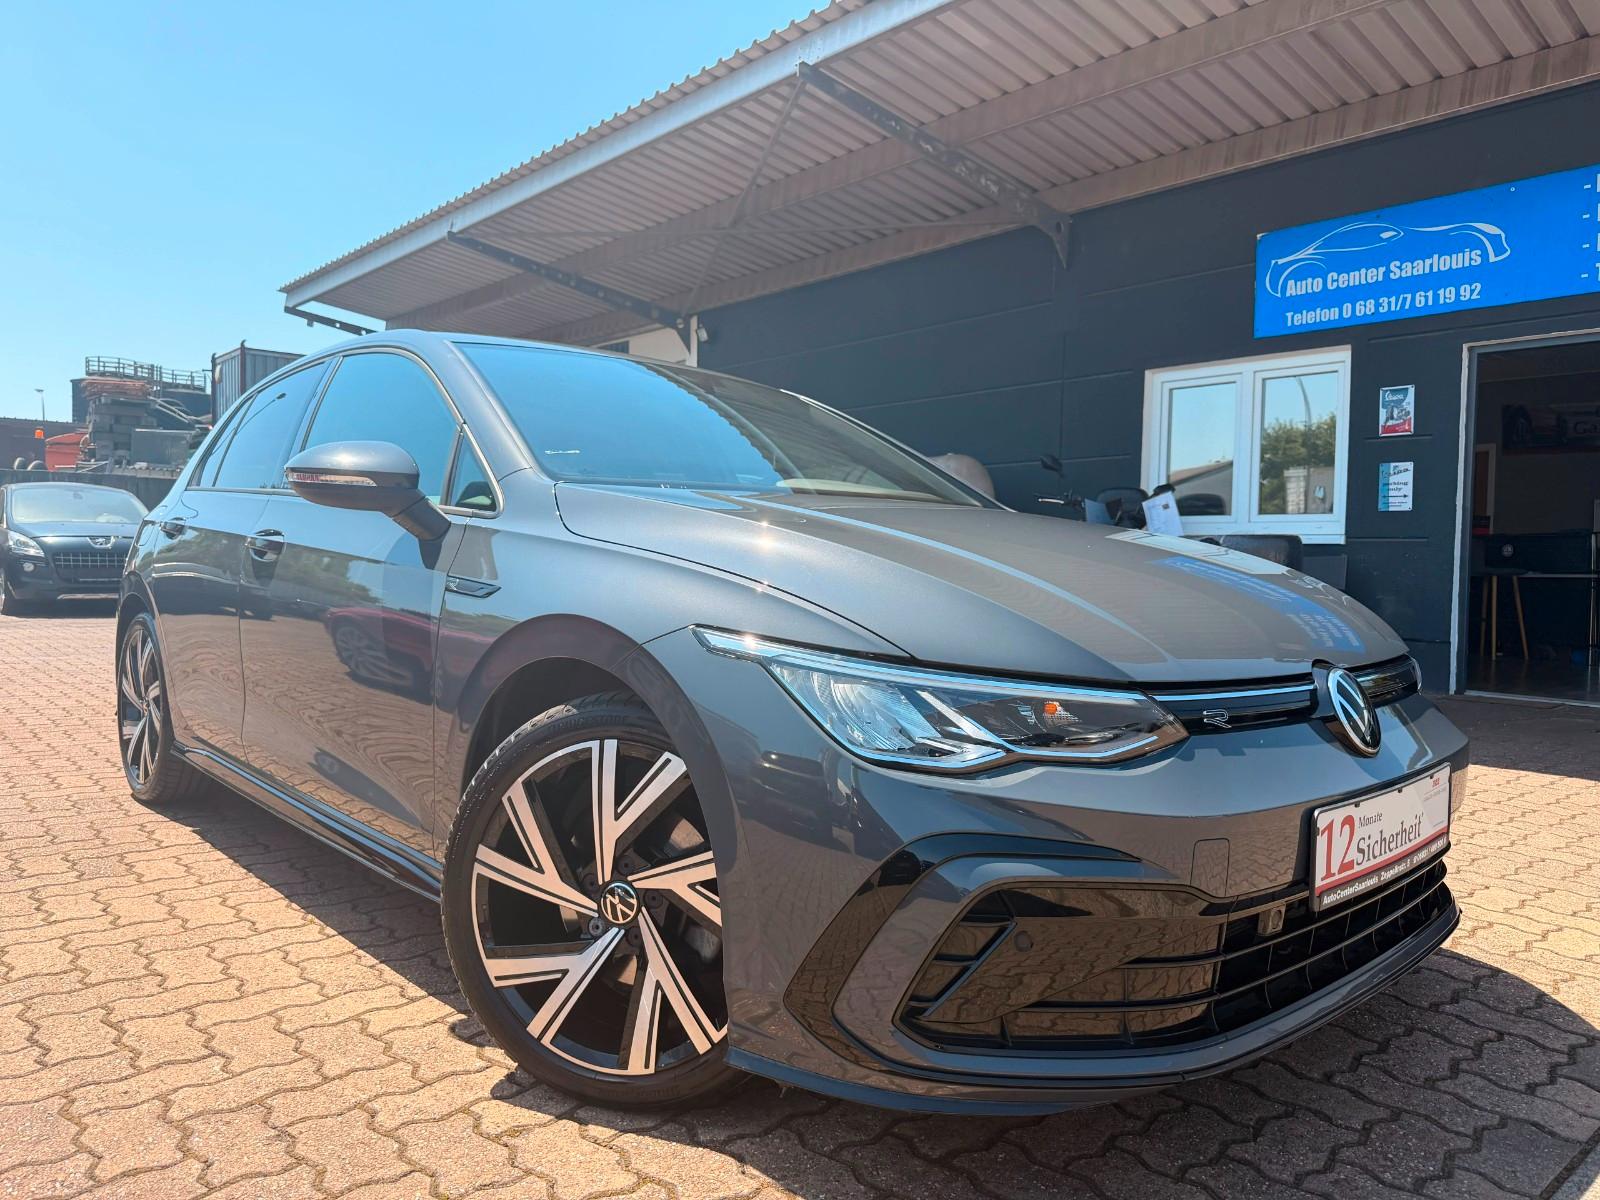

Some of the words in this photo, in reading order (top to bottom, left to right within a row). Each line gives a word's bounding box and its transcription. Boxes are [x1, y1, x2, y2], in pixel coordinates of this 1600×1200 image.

[1285, 275, 1322, 297] Auto
[1327, 265, 1385, 292] Center
[1389, 248, 1482, 278] Saarlouis
[1285, 305, 1339, 327] Telefon
[1342, 302, 1352, 319] 0
[1355, 298, 1375, 316] 68
[1379, 290, 1411, 314] 31/7
[1415, 288, 1433, 308] 61
[1437, 285, 1456, 305] 19
[1459, 282, 1482, 301] 92
[1320, 814, 1356, 882] 12
[1358, 812, 1383, 829] Monate
